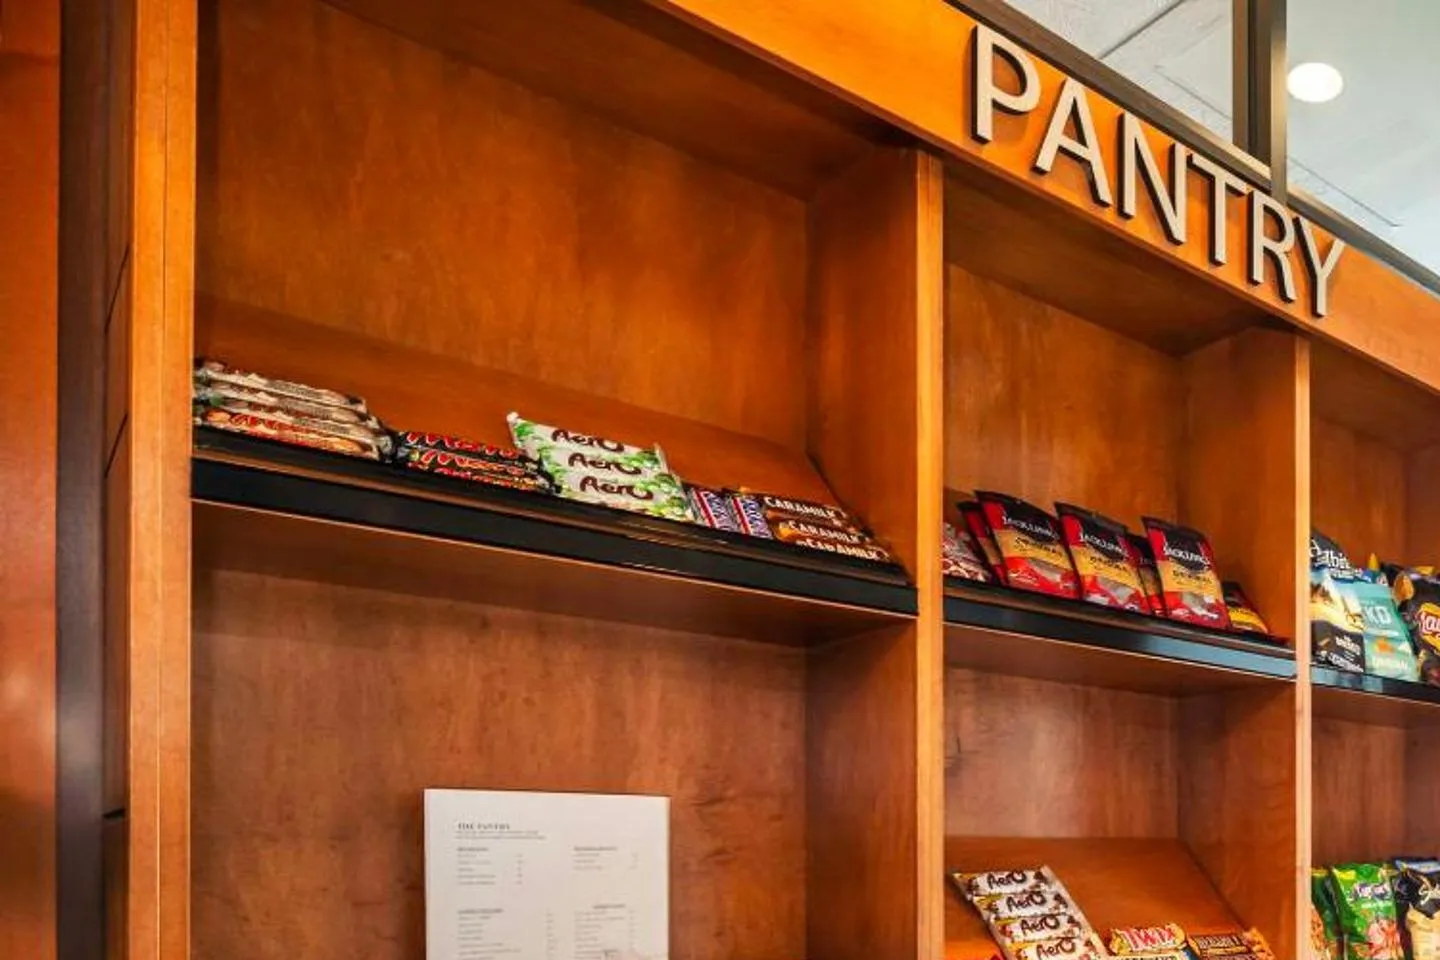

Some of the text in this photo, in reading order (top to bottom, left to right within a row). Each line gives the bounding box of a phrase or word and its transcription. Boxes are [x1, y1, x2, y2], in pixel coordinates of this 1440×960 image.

[971, 24, 1345, 318] PANTRY
[551, 429, 625, 453] Aero
[568, 452, 642, 475] Aero
[580, 476, 654, 500] Aero
[1364, 605, 1392, 635] KD
[986, 870, 1027, 890] Aero
[1006, 891, 1047, 913] Aero
[1020, 914, 1060, 936] Aero
[1036, 937, 1076, 960] Aero
